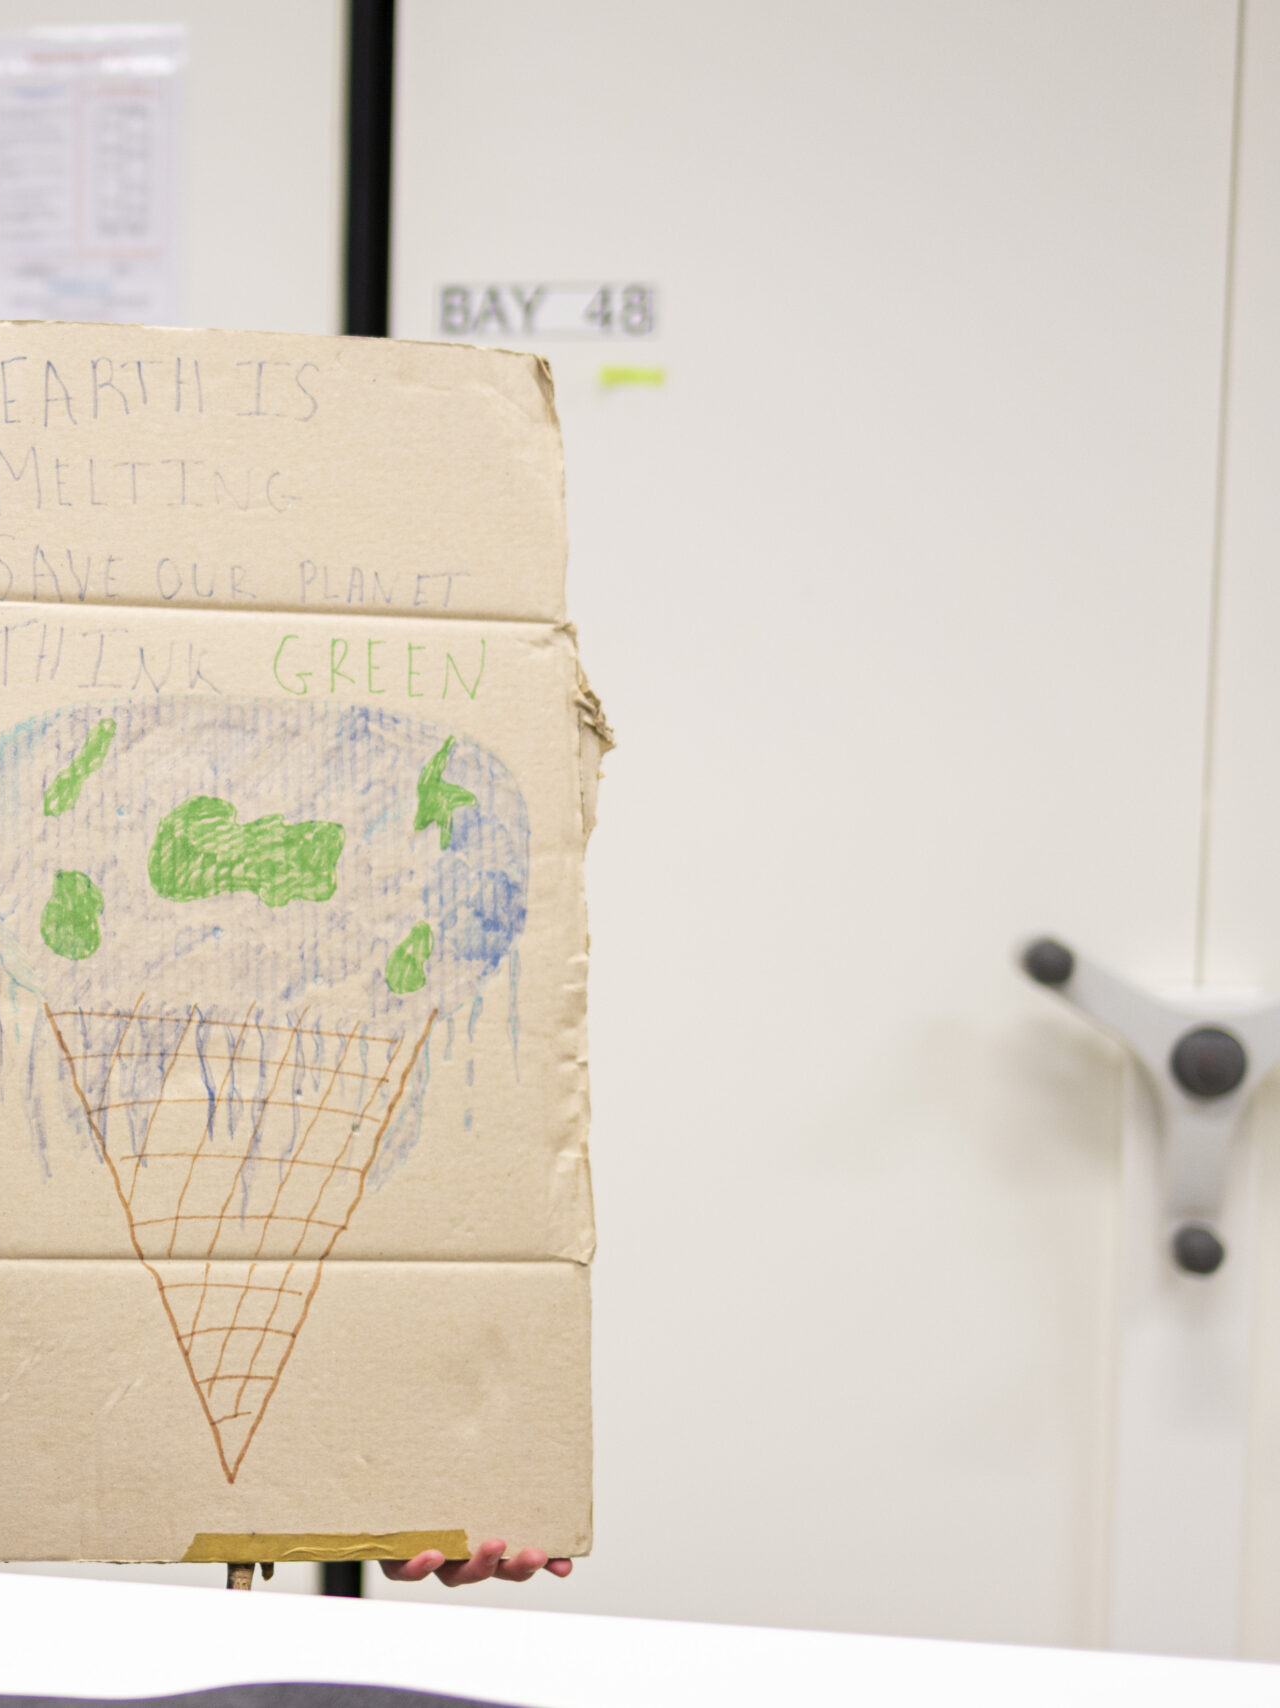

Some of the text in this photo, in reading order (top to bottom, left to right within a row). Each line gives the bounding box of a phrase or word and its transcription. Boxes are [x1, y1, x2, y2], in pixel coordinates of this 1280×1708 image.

[439, 284, 654, 336] BAY 48
[1, 356, 320, 428] EARTH IS
[156, 557, 257, 600] OUR
[299, 559, 471, 608] PLANET
[273, 634, 486, 700] GREEN
